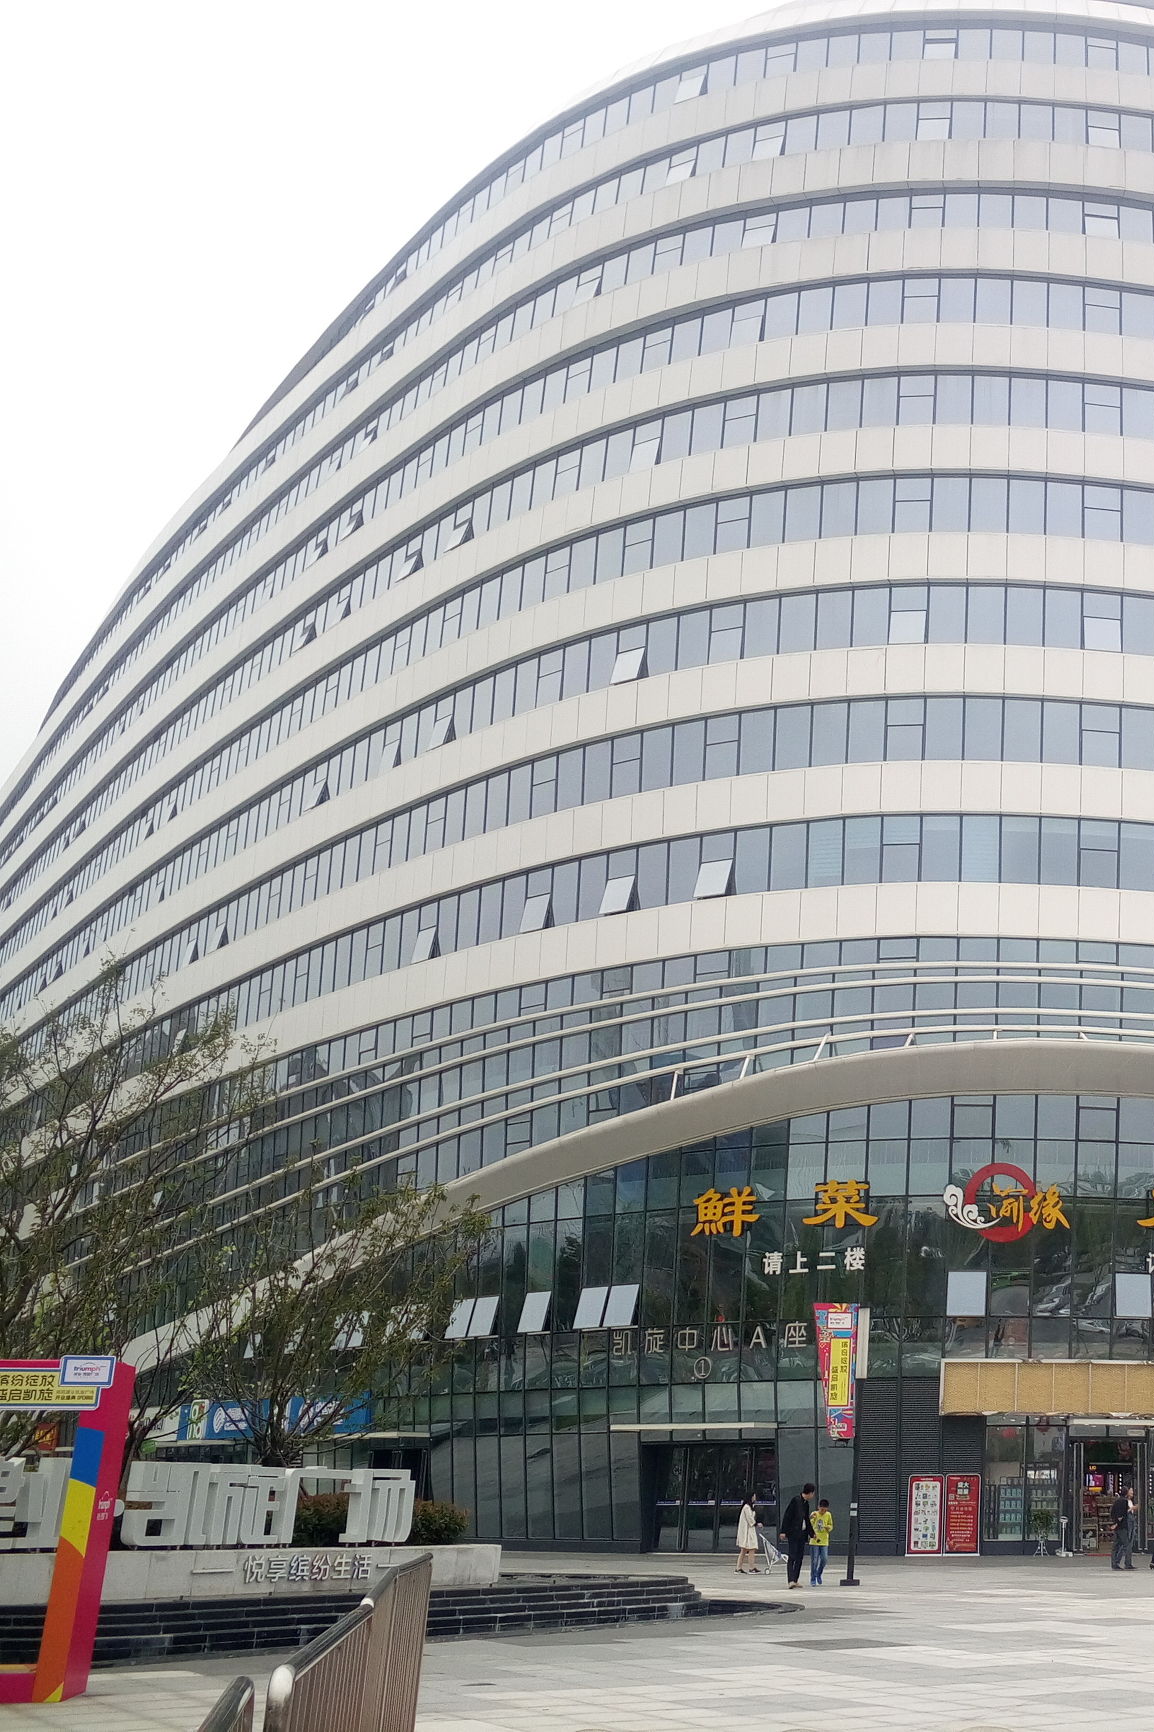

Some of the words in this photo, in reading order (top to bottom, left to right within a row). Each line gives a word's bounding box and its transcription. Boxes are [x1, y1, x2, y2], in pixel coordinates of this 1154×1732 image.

[762, 1247, 865, 1276] 请上二楼
[243, 1553, 373, 1583] 悦享缤纷生活
